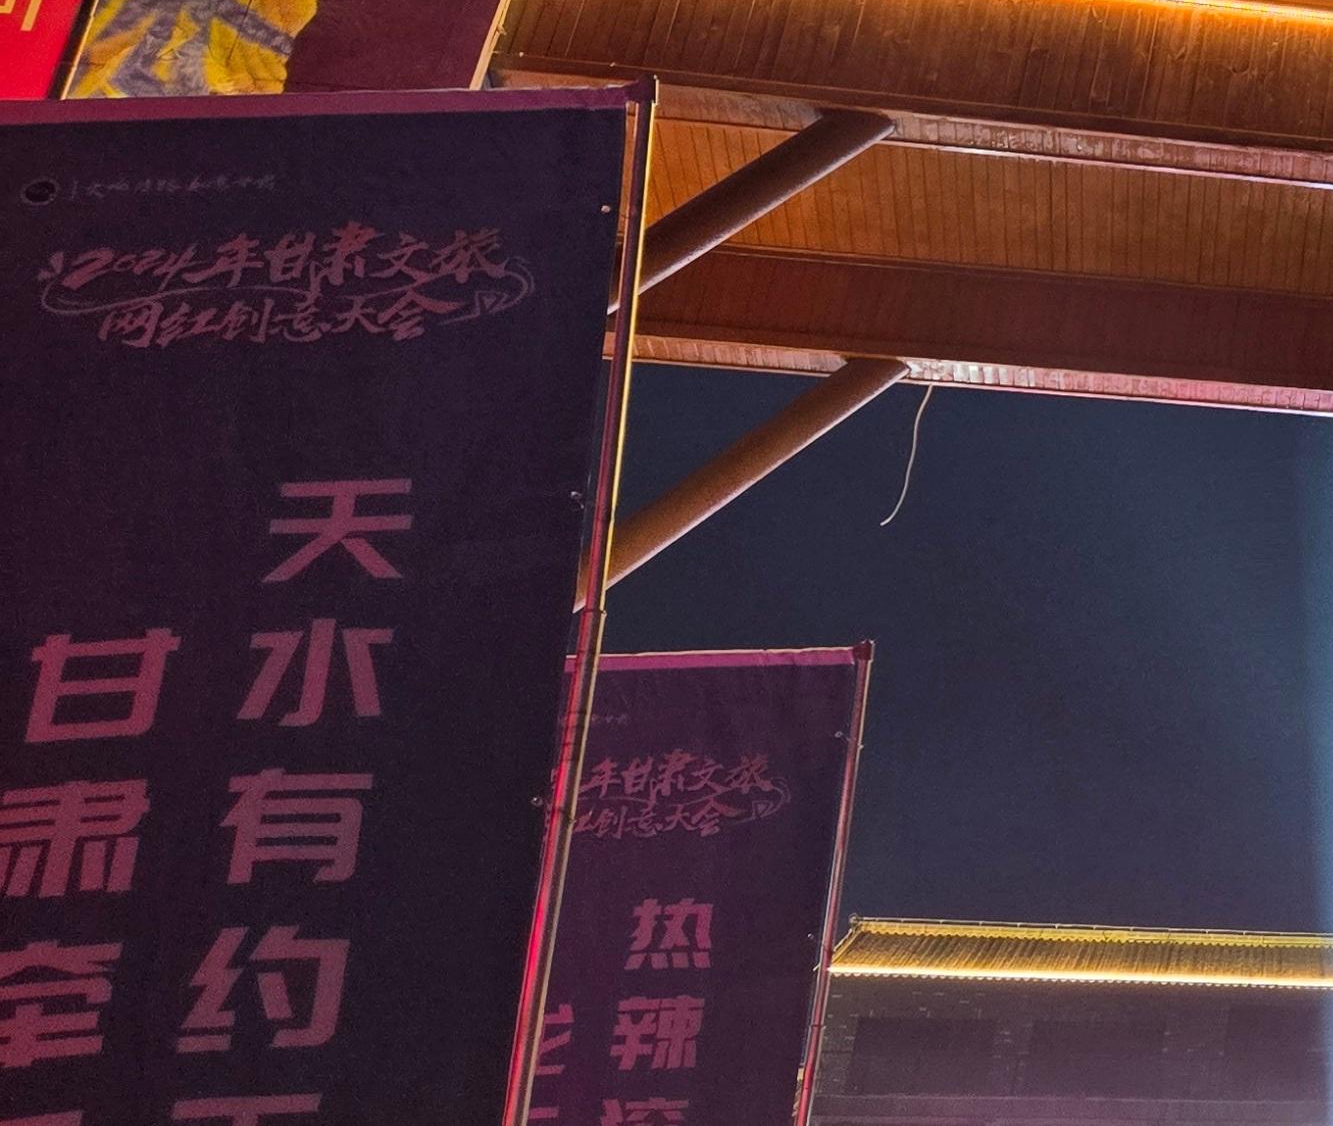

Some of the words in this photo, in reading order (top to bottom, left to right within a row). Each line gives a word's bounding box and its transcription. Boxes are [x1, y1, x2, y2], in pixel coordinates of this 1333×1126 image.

[58, 220, 506, 290] 2024年甘肃文旅
[97, 287, 462, 348] 网红创意大会
[0, 627, 180, 1126] 甘肃牵
[174, 477, 412, 1126] 天水有约
